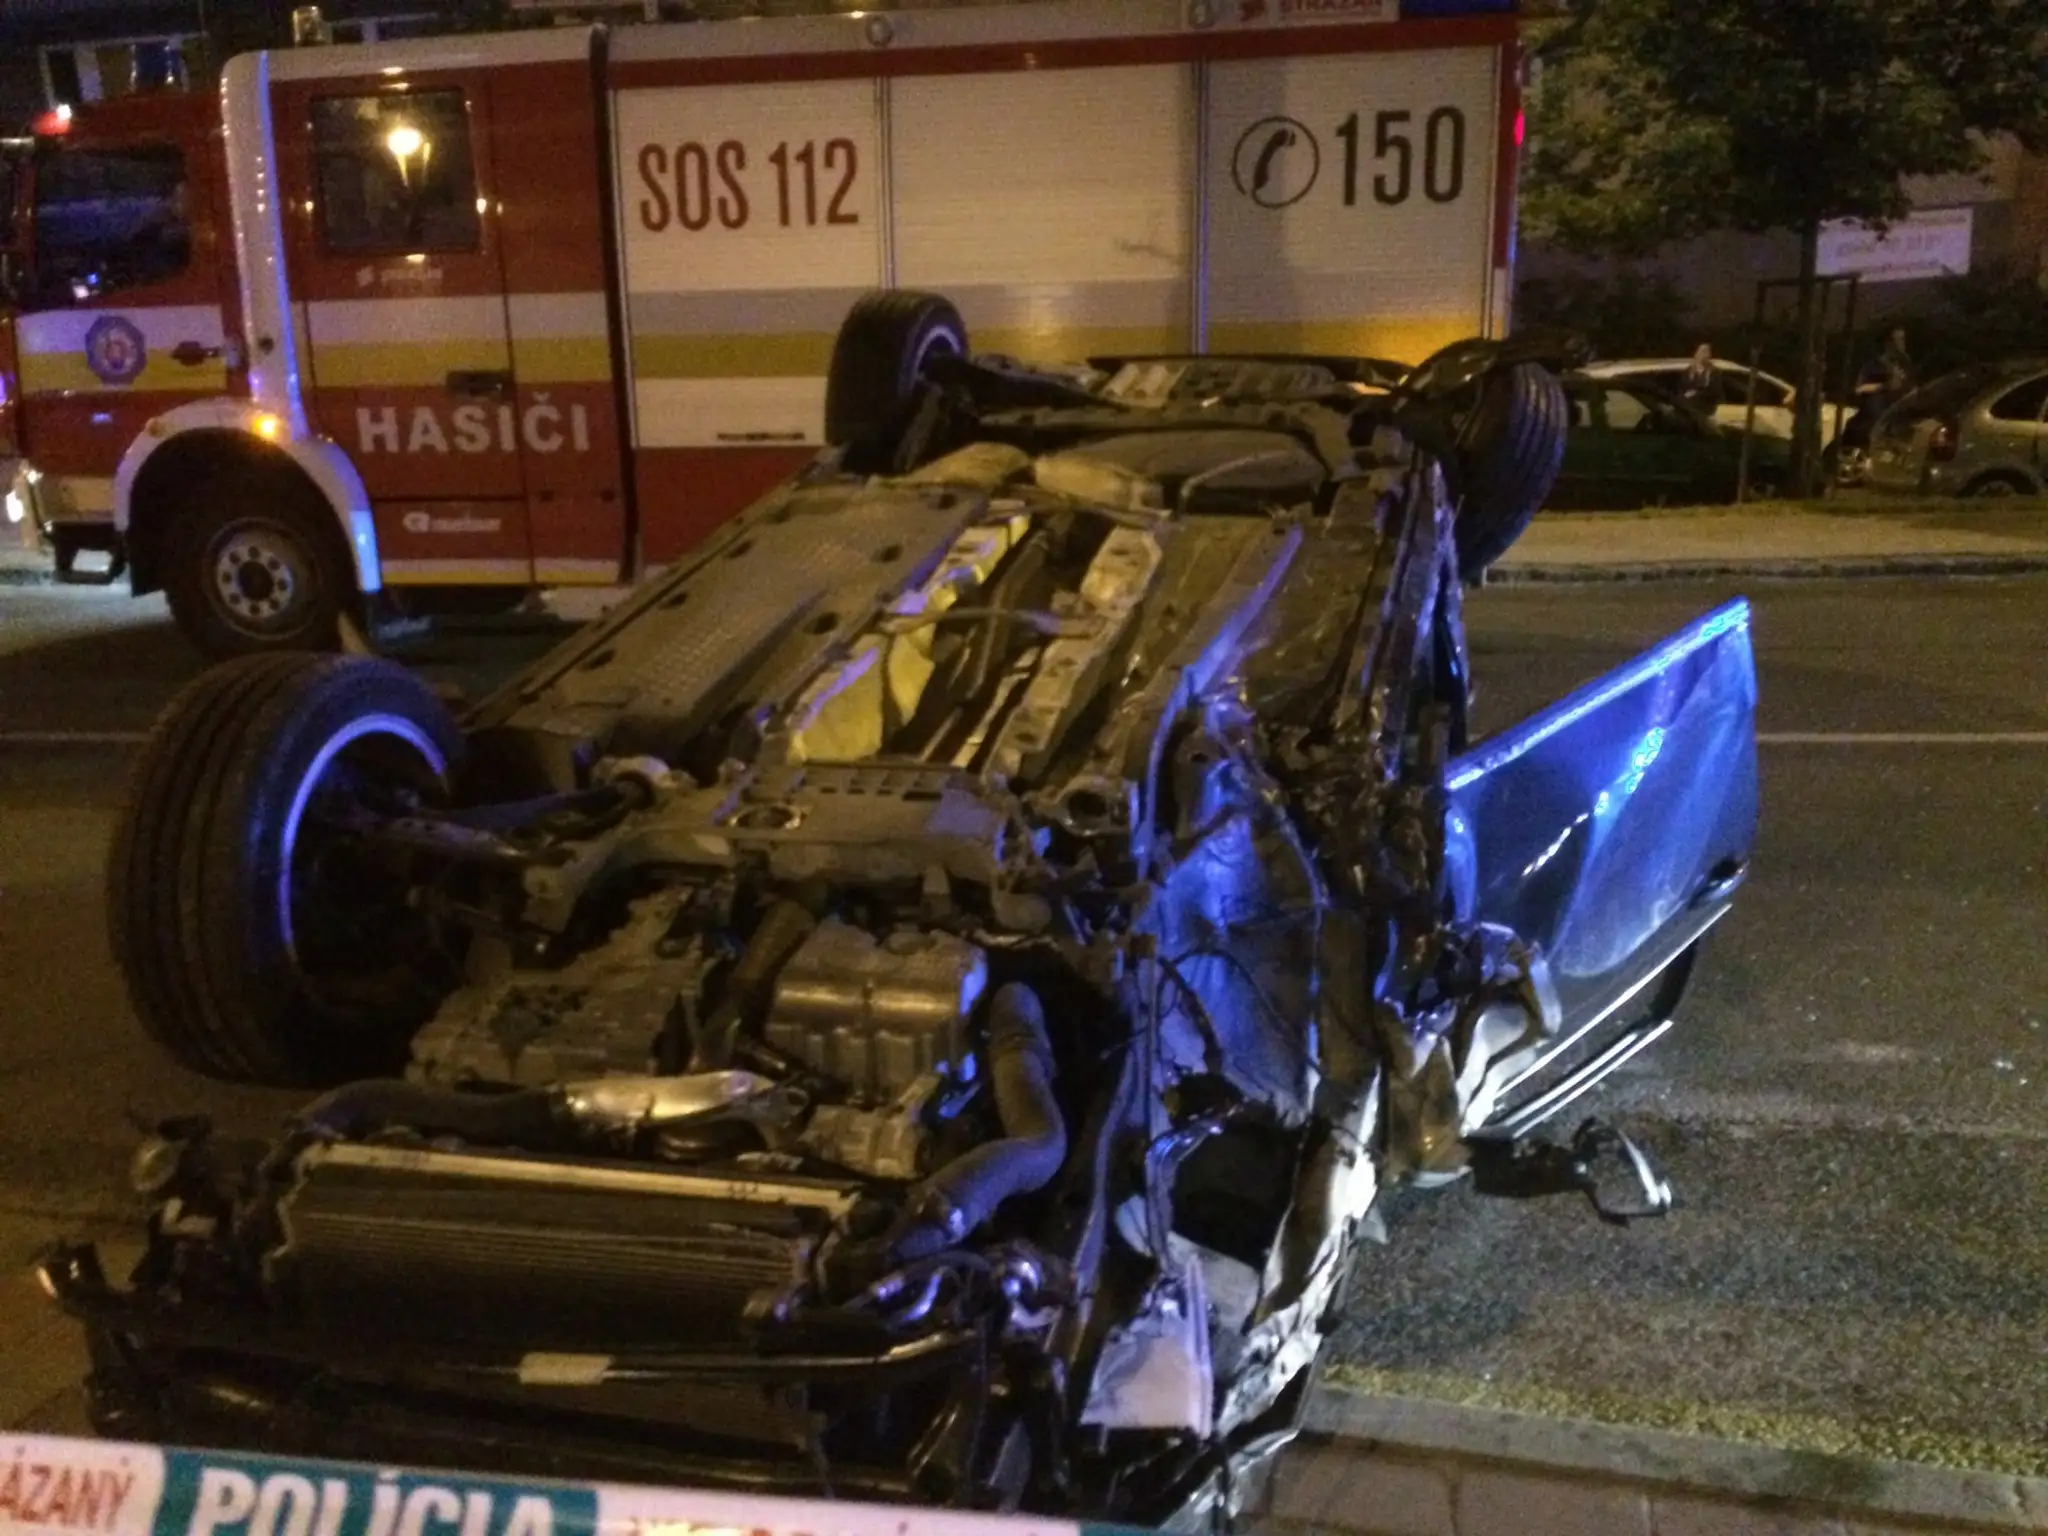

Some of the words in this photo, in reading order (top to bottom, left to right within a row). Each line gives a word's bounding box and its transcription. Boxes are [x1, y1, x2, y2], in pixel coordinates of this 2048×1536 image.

[638, 141, 749, 231] SOS
[768, 137, 859, 227] 112
[1336, 106, 1466, 206] 150
[356, 391, 590, 454] HASIČI
